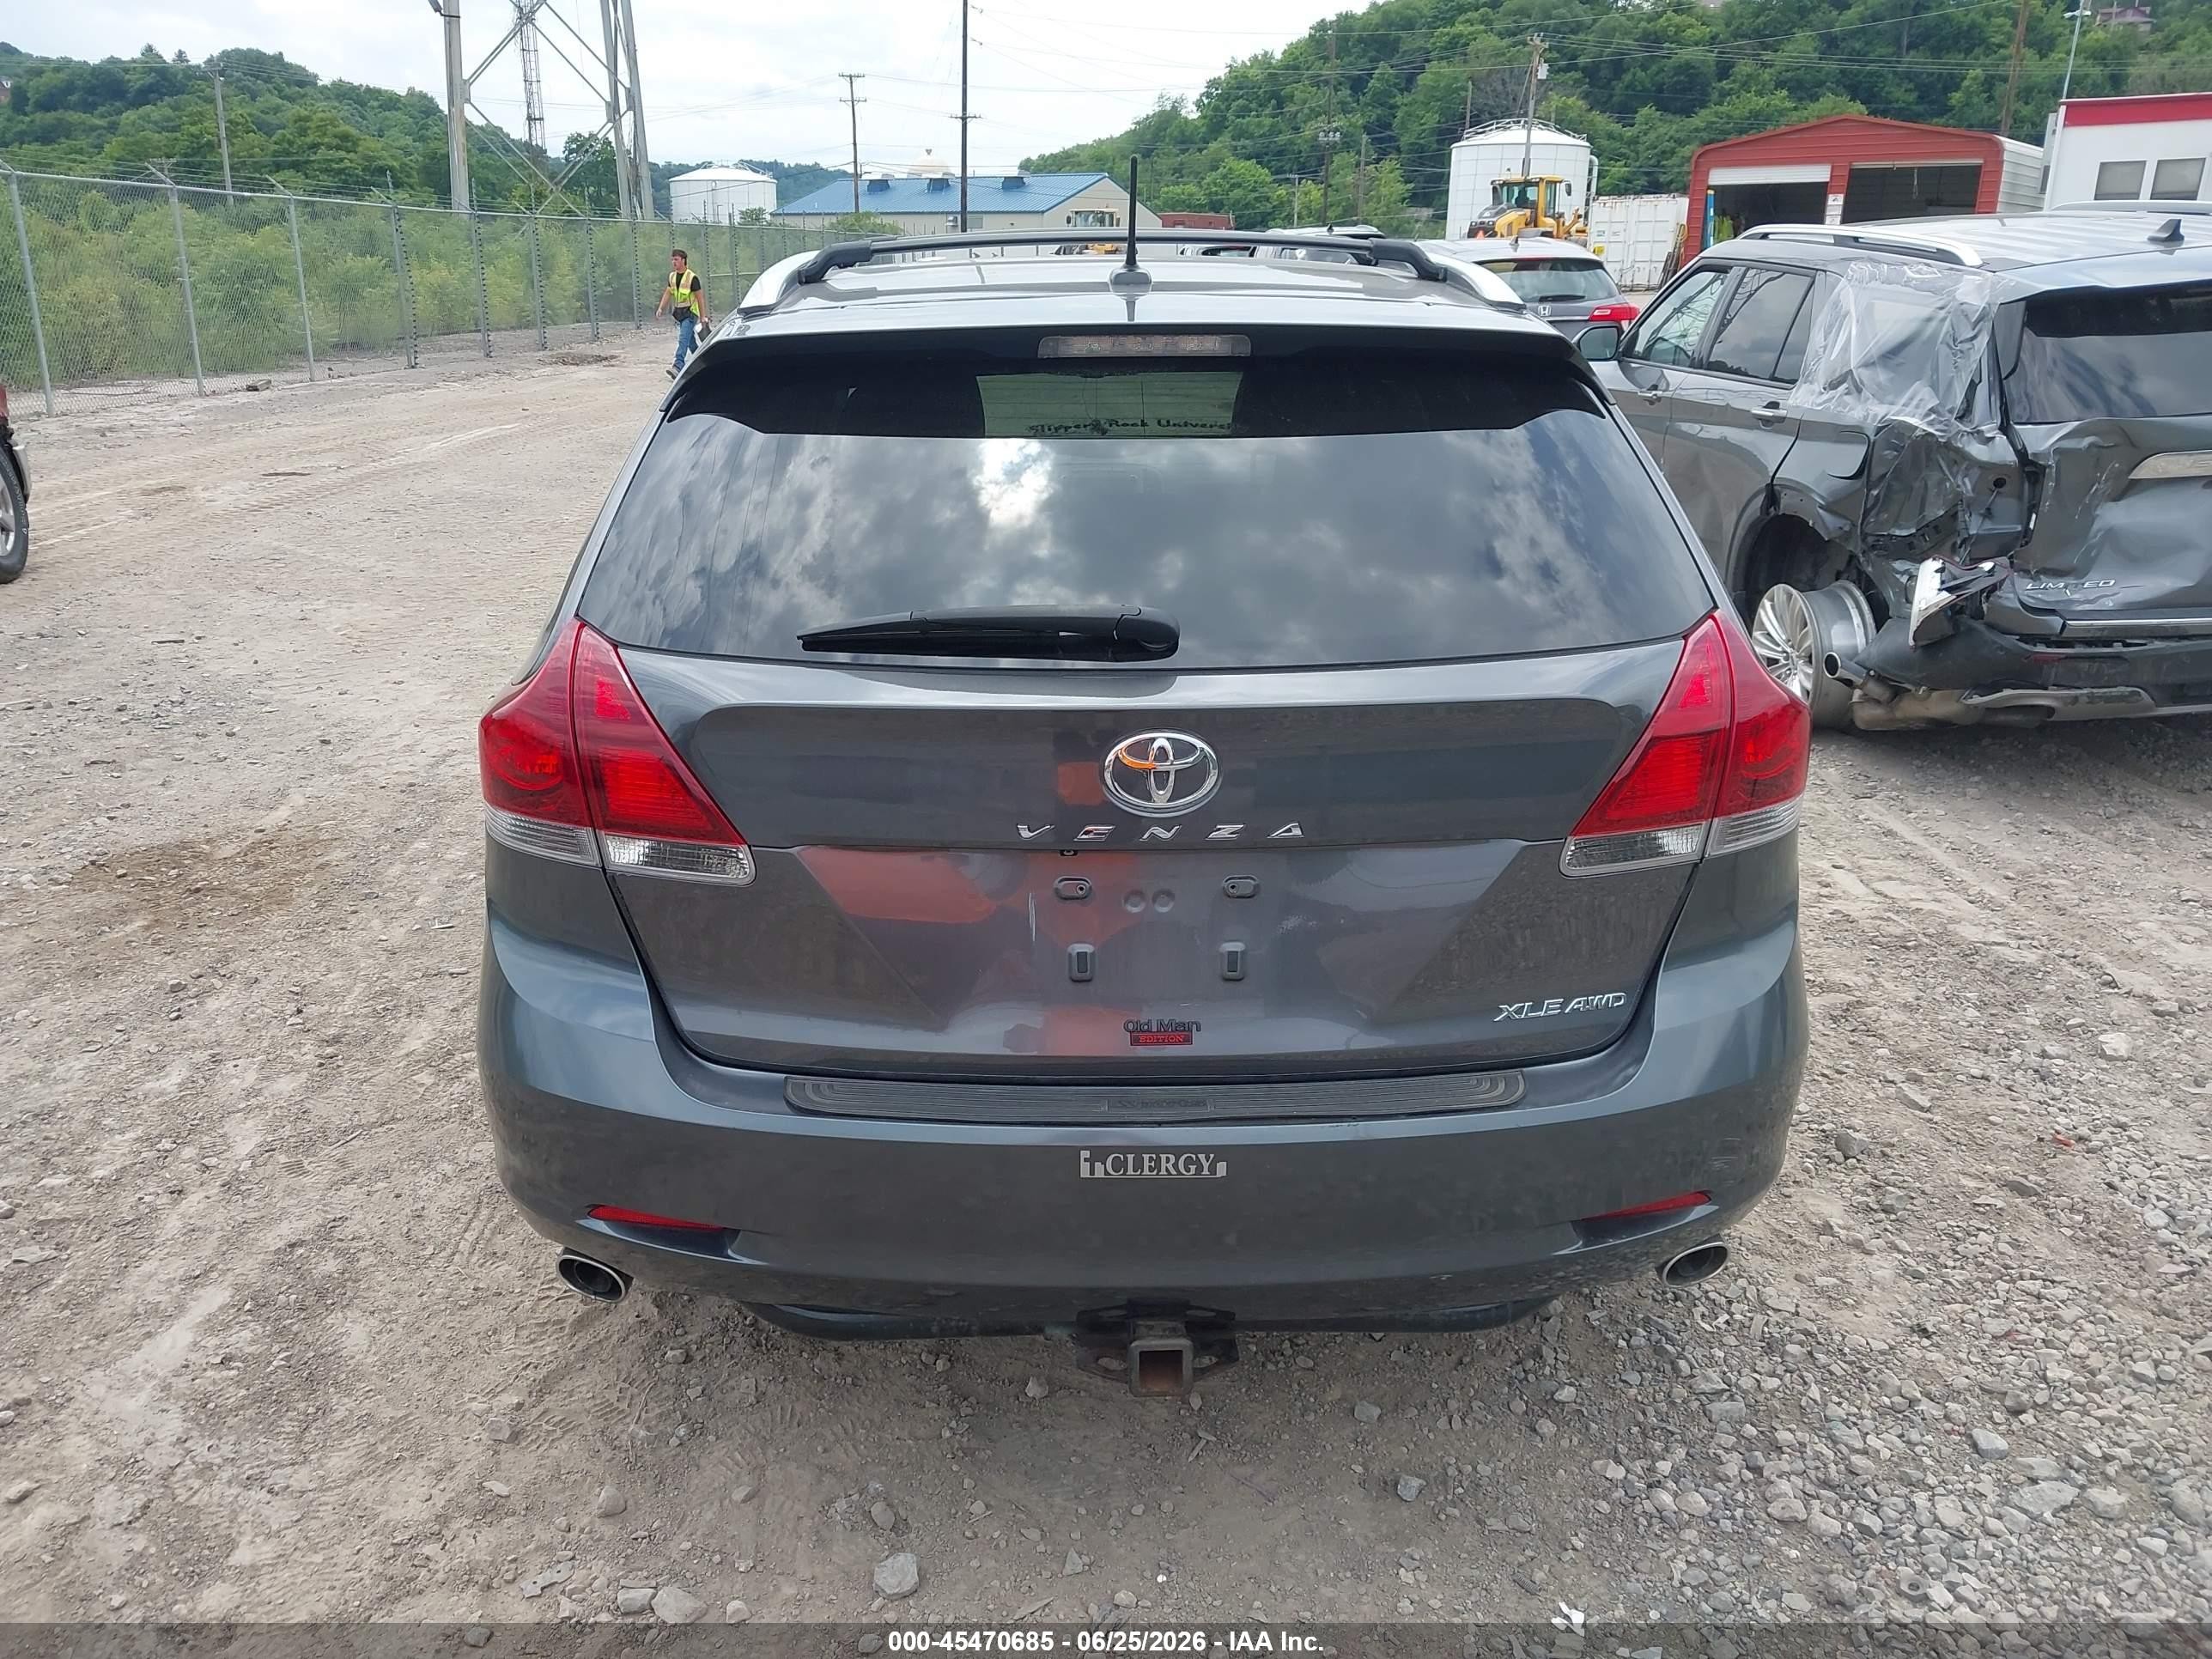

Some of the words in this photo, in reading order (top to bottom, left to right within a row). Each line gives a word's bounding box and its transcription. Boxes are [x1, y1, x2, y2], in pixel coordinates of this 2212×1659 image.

[1106, 418, 1148, 428] Rock
[2025, 580, 2117, 591] LIMED
[1017, 823, 1304, 842] VENZA
[1493, 998, 1565, 1022] XLE
[1565, 992, 1626, 1013] AWD
[1123, 1018, 1152, 1033] Old
[1157, 1018, 1202, 1033] Man
[1139, 1035, 1185, 1043] EDITION
[1105, 1153, 1215, 1176] CLERGY
